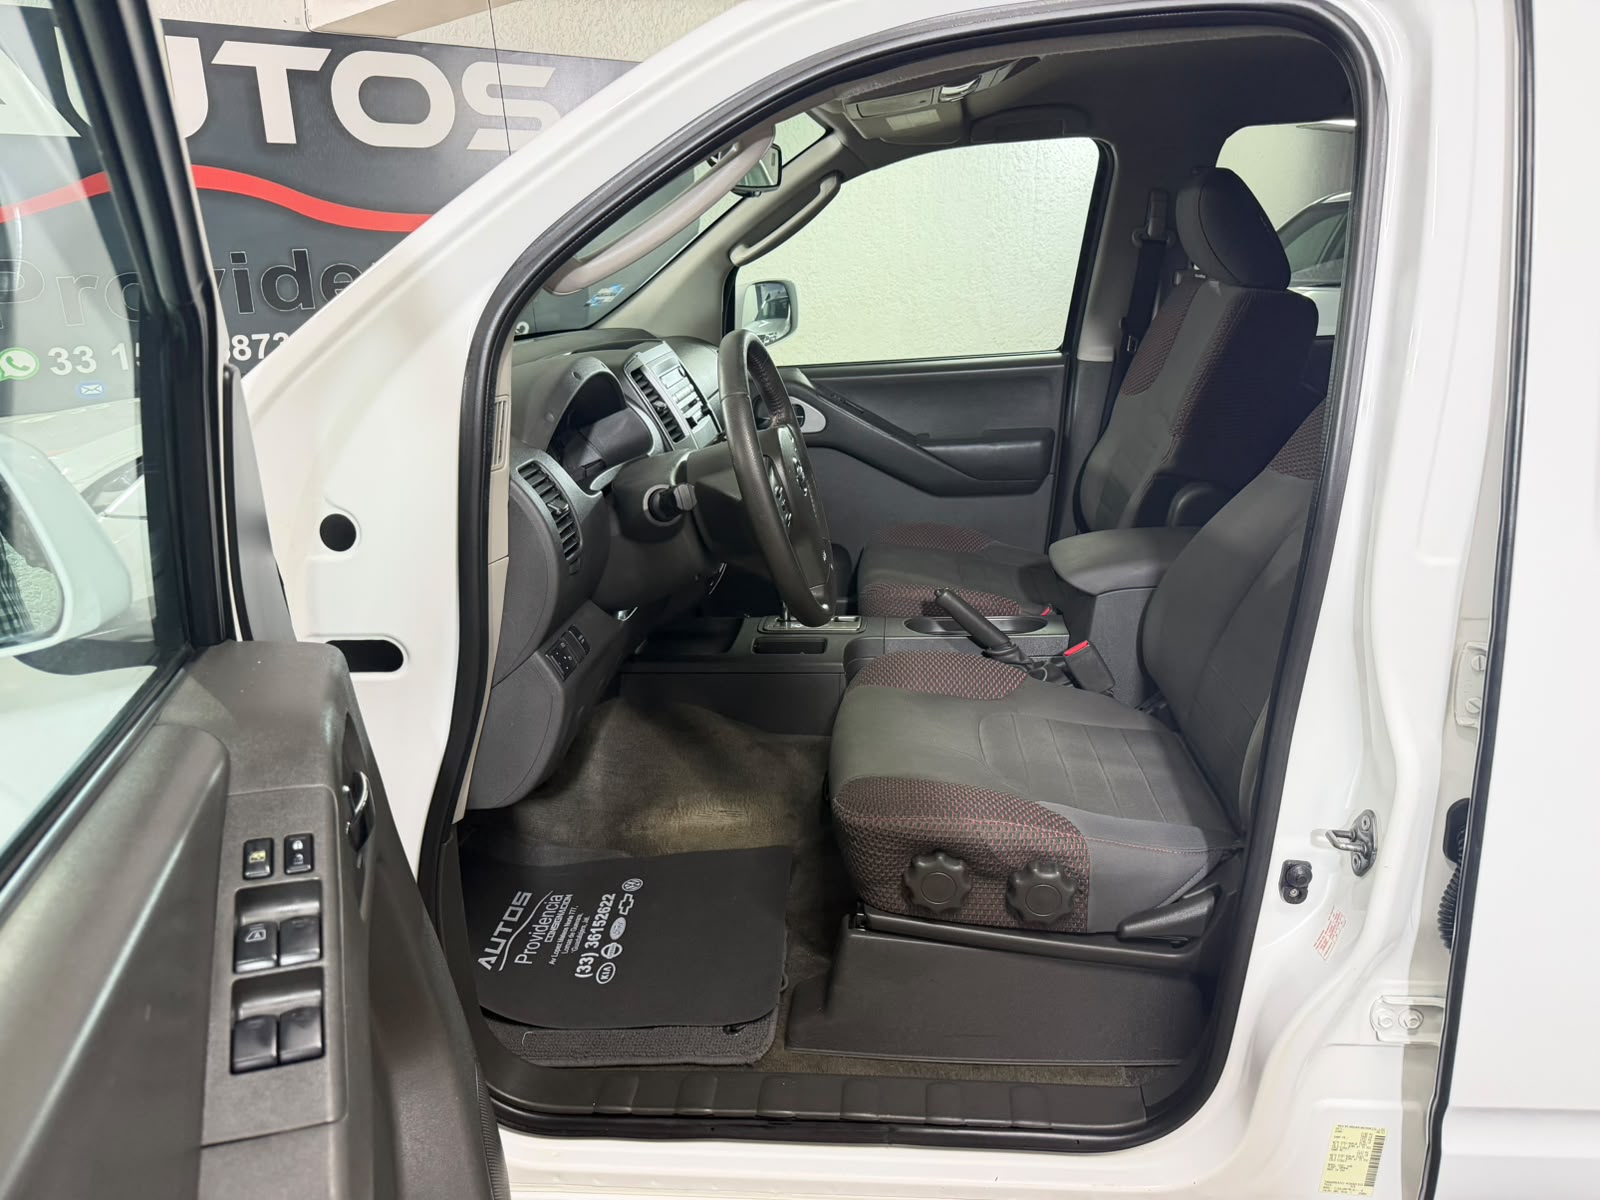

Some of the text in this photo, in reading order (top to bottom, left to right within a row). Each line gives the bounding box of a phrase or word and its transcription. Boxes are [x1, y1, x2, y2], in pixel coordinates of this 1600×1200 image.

[48, 345, 97, 375] 33
[477, 891, 532, 971] AUTOS
[513, 894, 564, 964] Providencia
[574, 893, 616, 979] (33) 36152622
[600, 966, 612, 980] KIA
